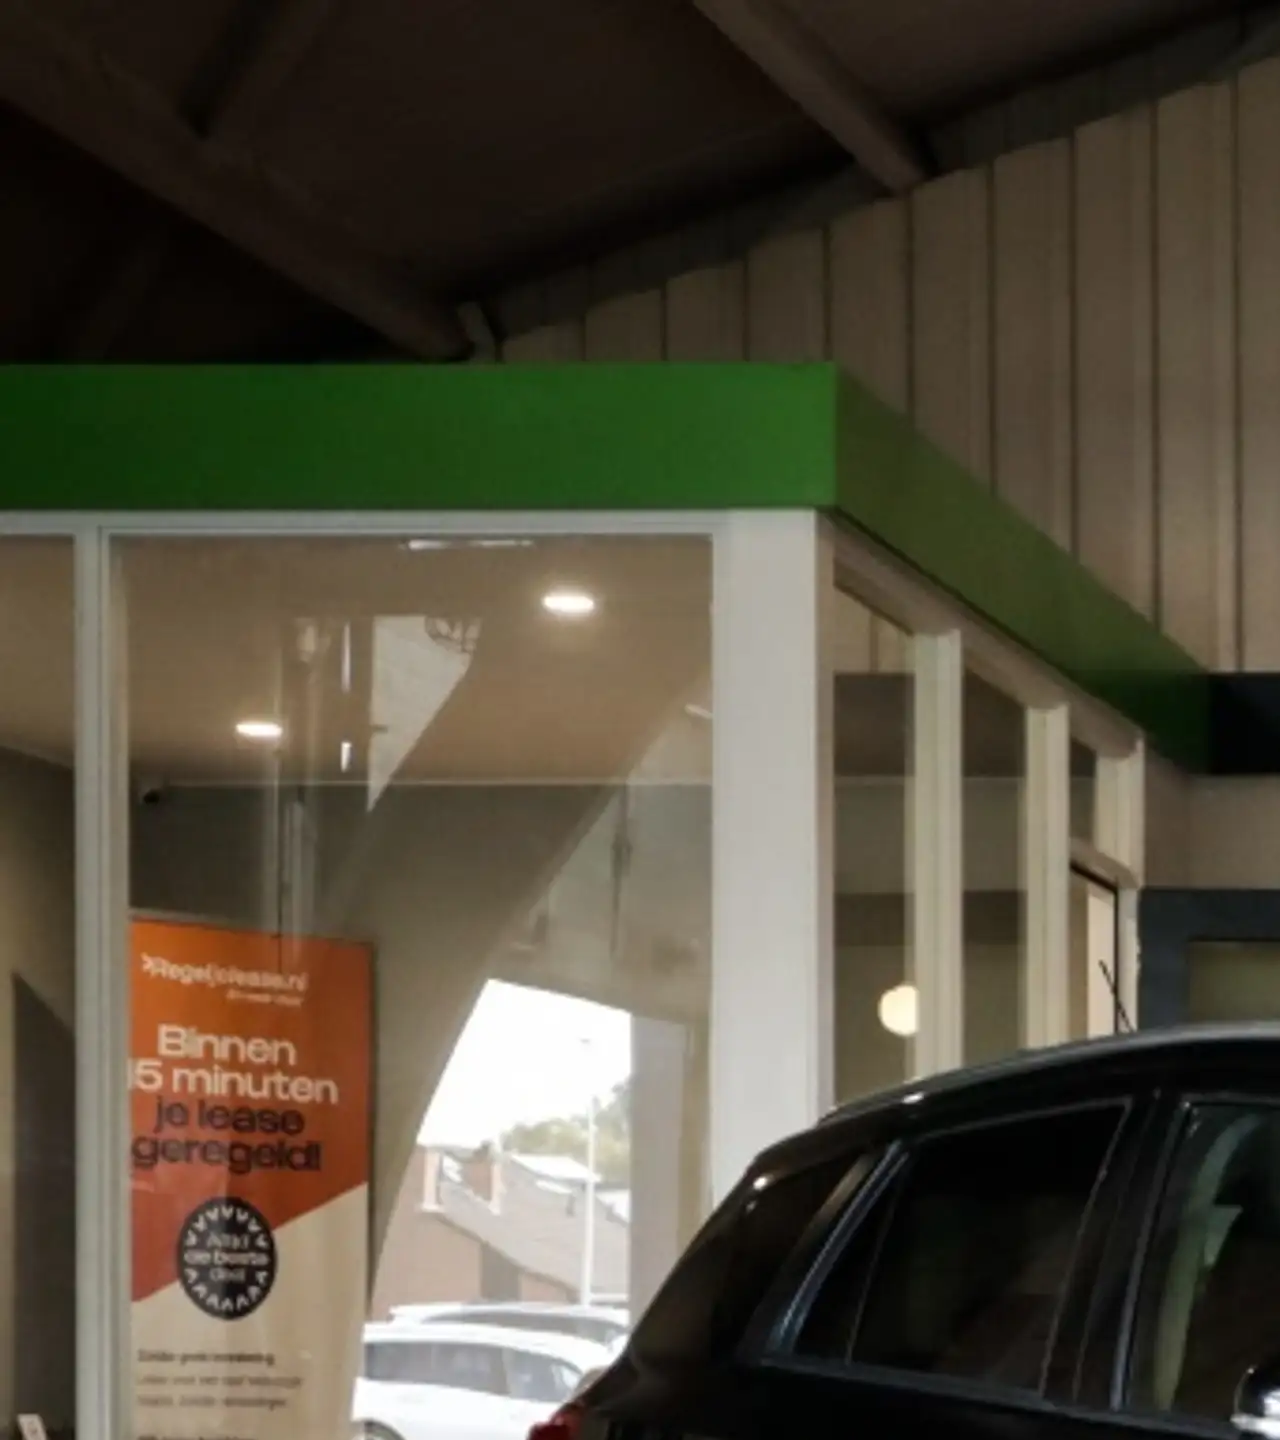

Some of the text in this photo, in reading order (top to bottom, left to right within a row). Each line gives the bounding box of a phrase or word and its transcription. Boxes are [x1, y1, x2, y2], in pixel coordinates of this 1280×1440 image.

[157, 1023, 298, 1067] Binnen
[171, 1064, 339, 1104] minuten
[153, 1095, 306, 1136] je lease
